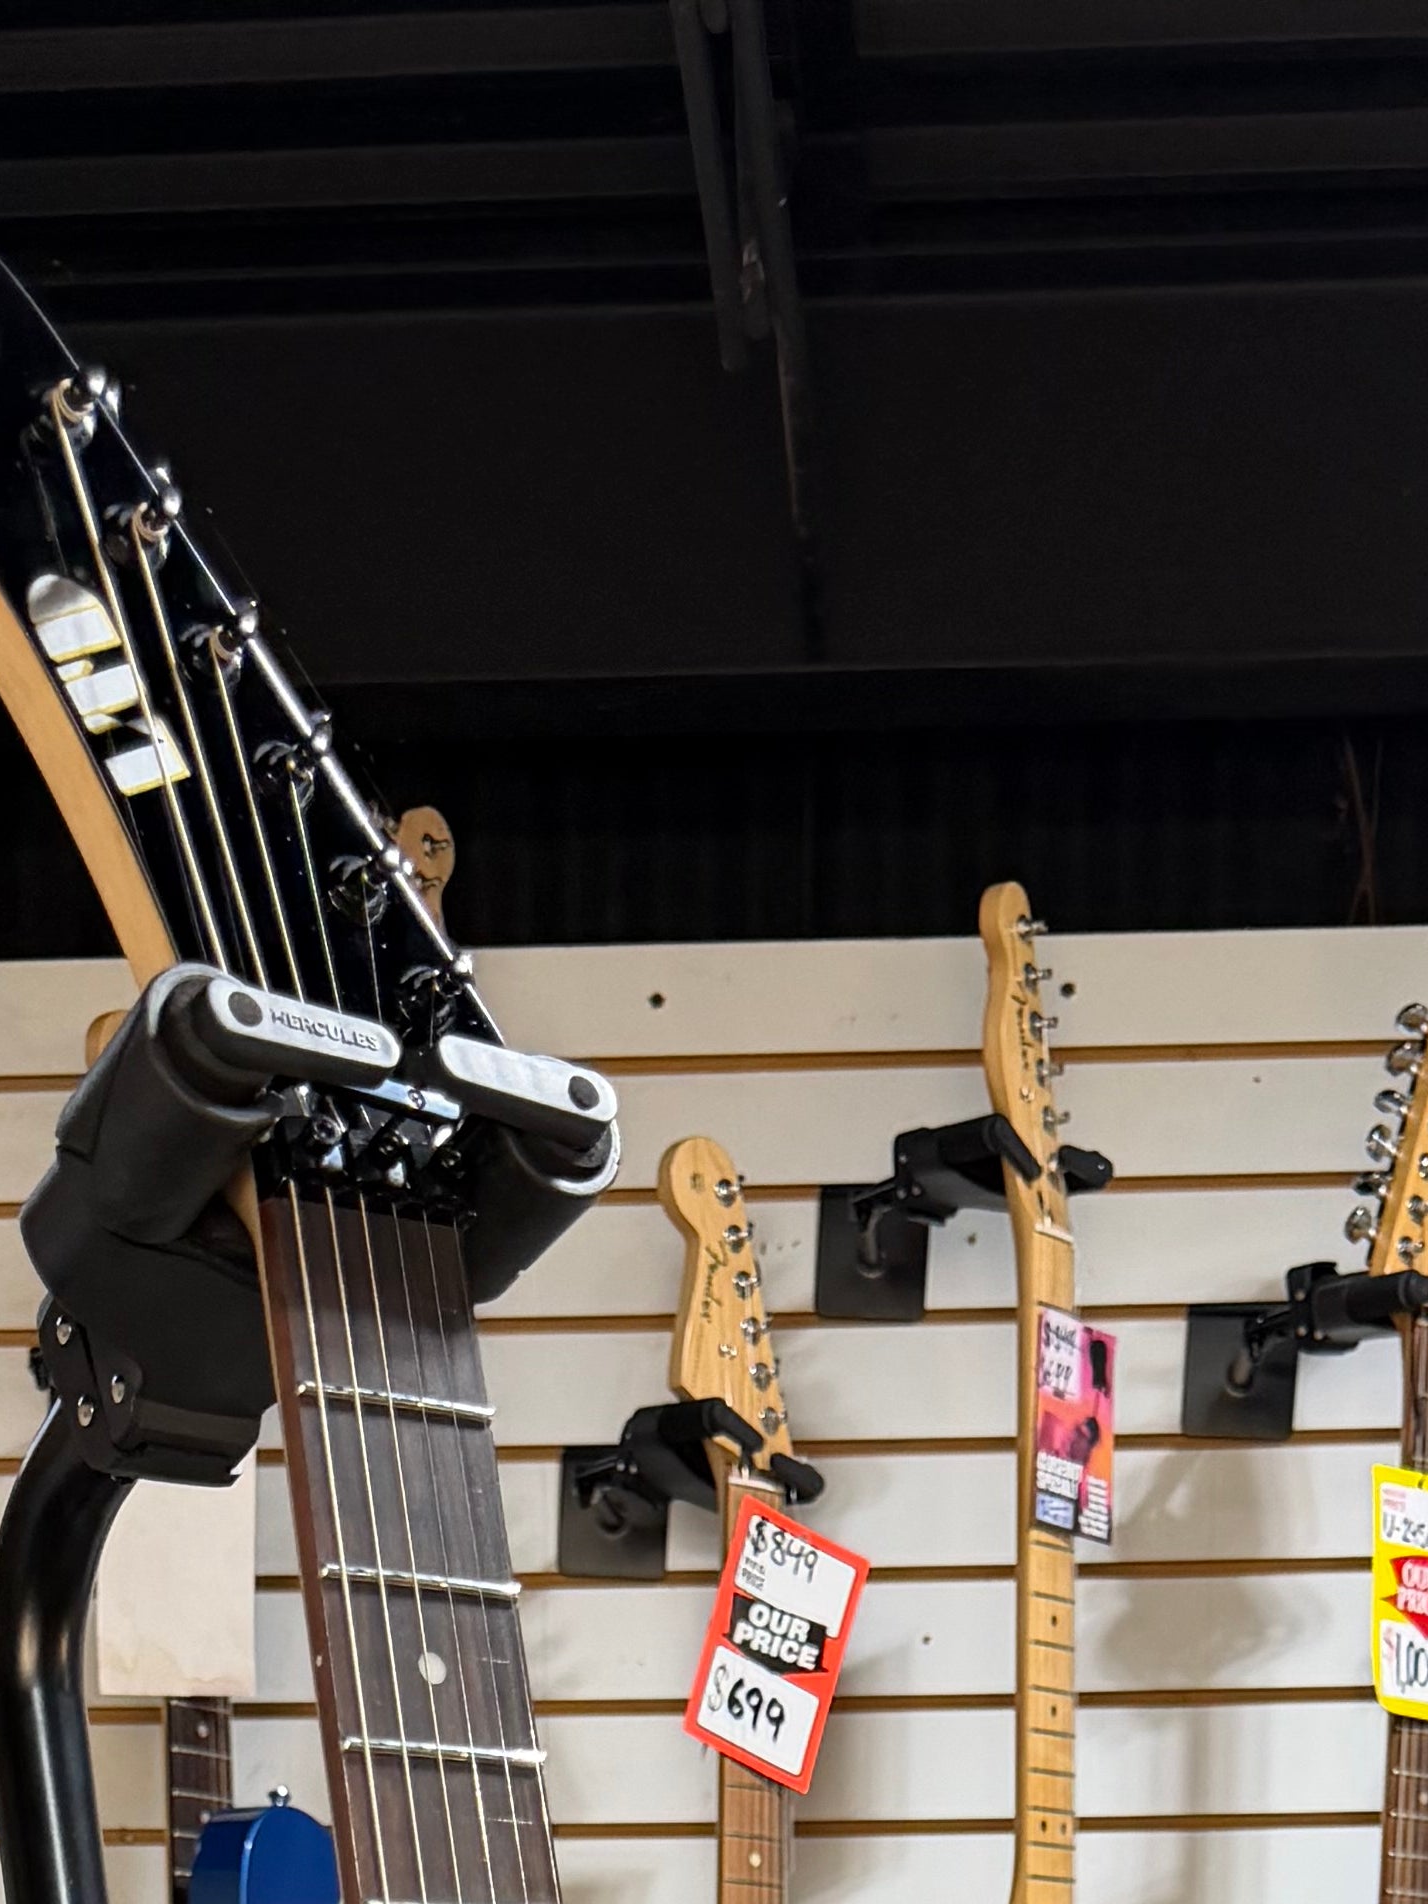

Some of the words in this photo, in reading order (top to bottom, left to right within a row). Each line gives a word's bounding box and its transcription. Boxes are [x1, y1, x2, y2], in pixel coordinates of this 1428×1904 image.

[269, 1007, 379, 1052] HERCULES
[751, 1519, 819, 1584] $849
[733, 1622, 820, 1672] PRICE
[748, 1601, 811, 1644] OUR
[707, 1664, 786, 1744] $699
